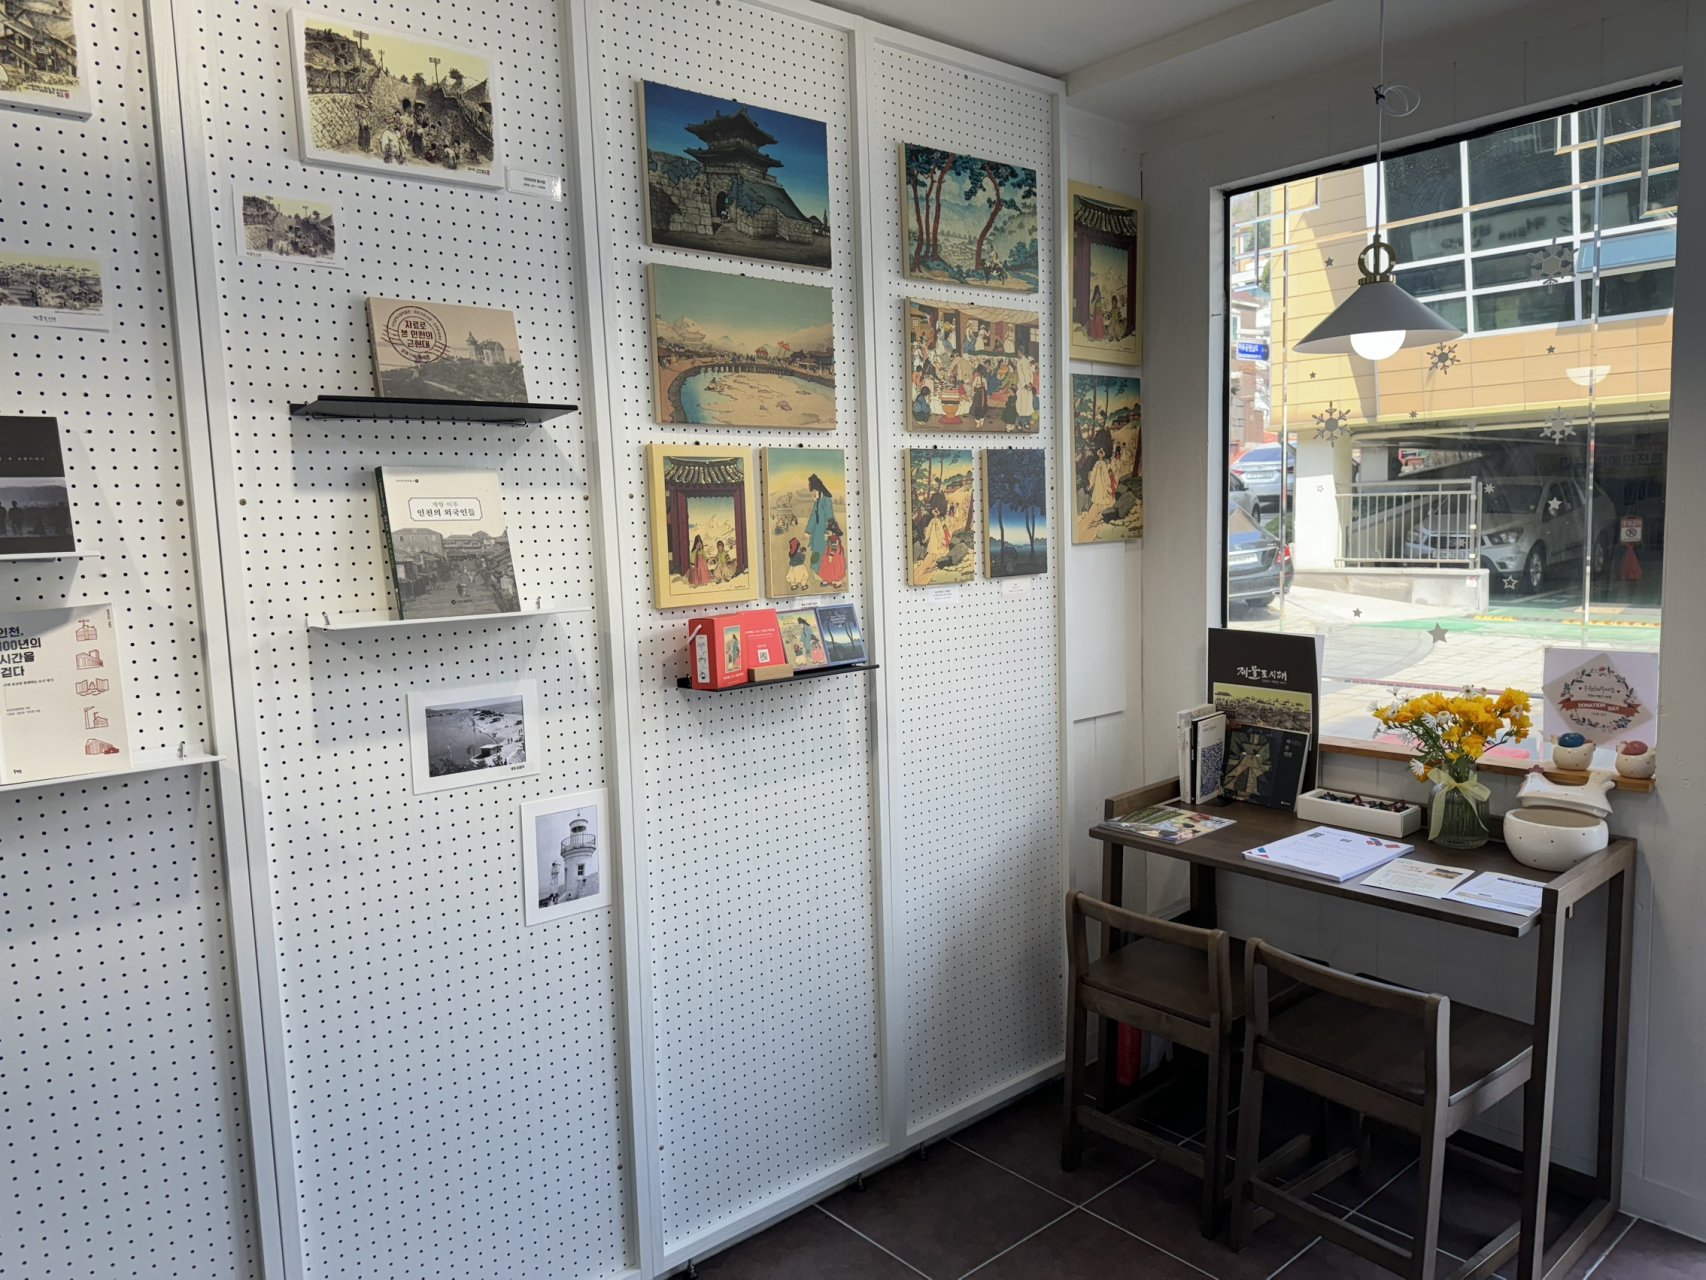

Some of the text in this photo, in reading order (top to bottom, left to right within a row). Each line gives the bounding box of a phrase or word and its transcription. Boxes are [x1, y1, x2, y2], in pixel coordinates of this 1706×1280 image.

[405, 320, 426, 330] 자료로
[400, 329, 409, 338] 본
[411, 330, 433, 339] 인천의
[407, 339, 430, 348] 근현대
[417, 508, 475, 518] 인천의 외국인들
[0, 651, 35, 665] 시간을
[1, 665, 25, 678] 걷다
[1237, 665, 1287, 681] 제물포시대
